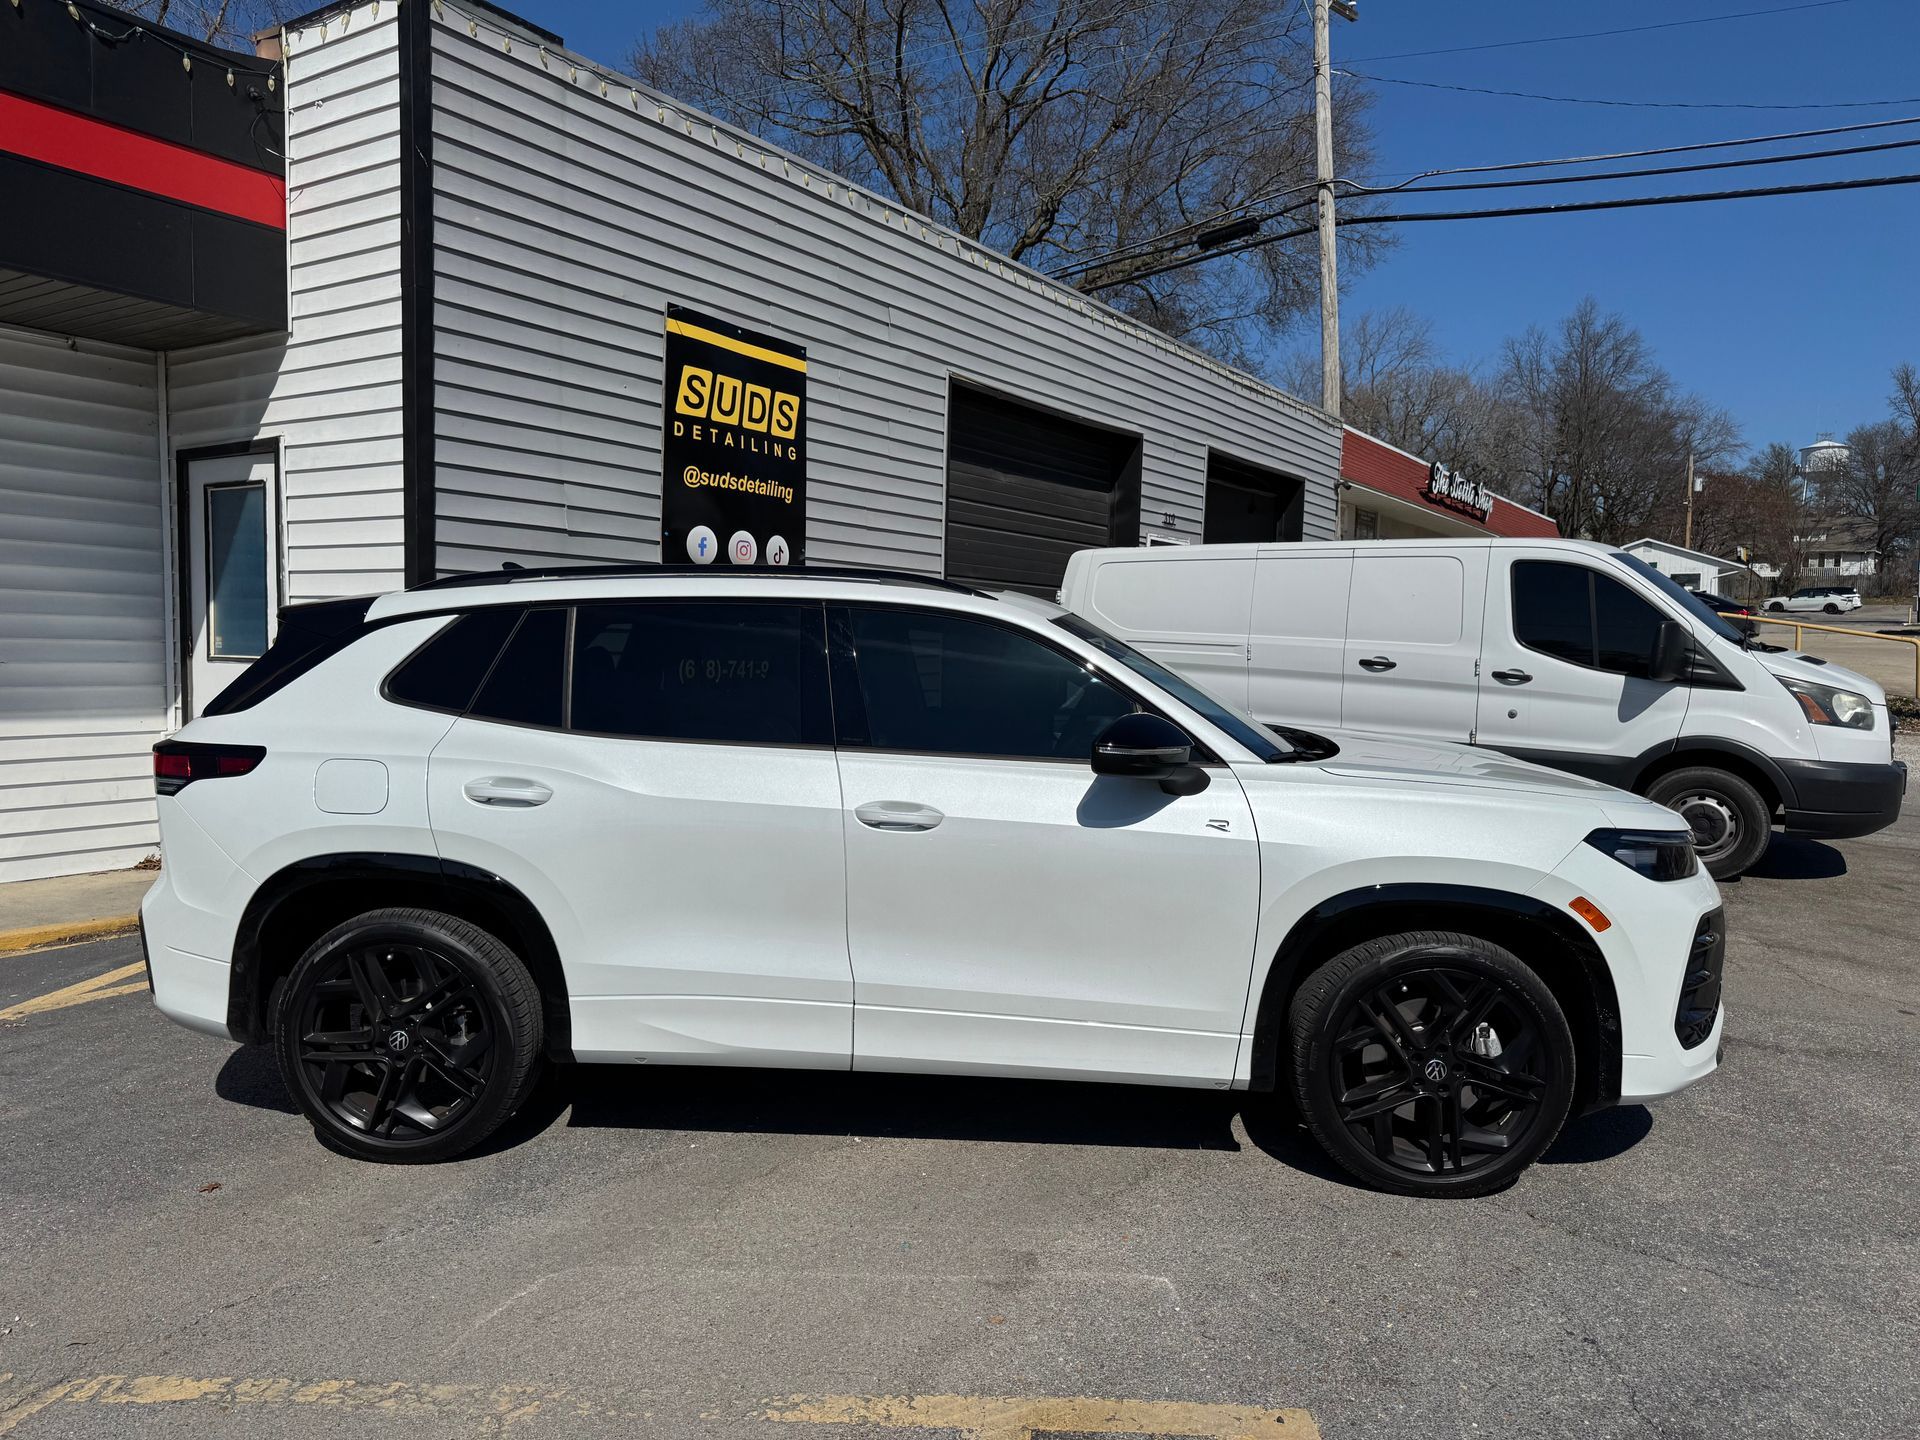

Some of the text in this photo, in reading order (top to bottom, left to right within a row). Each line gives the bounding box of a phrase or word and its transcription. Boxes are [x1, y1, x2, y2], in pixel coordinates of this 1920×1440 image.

[681, 372, 796, 433] SUDS
[674, 421, 797, 461] DETAILING
[683, 465, 794, 504] @sudsdetailing
[1432, 461, 1450, 494] The
[1475, 482, 1494, 521] Shop
